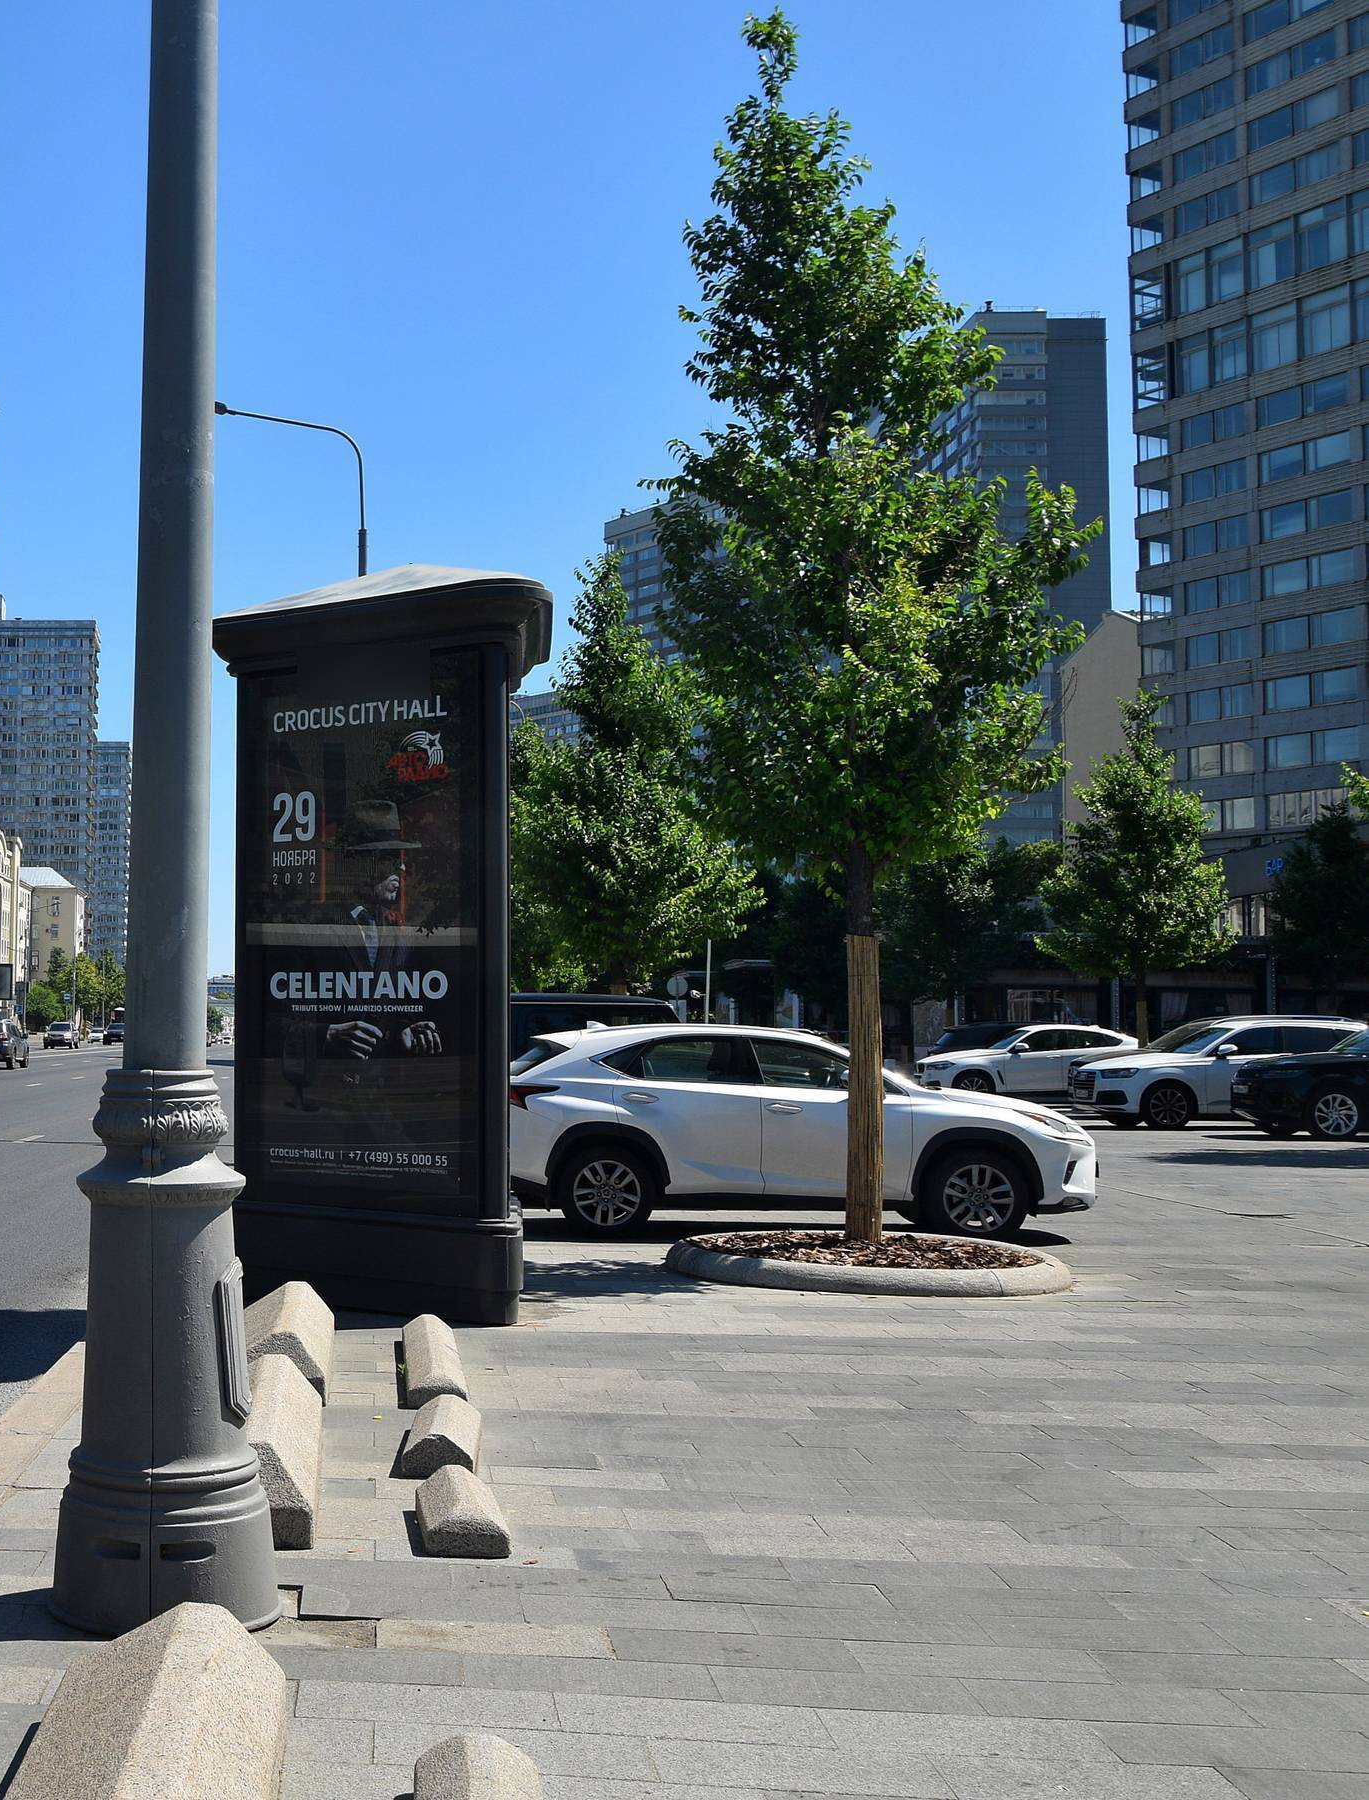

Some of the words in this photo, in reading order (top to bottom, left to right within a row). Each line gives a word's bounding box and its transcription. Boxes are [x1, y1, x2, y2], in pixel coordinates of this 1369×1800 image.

[273, 706, 345, 733] CROCUS
[348, 701, 390, 726] CITY
[393, 695, 448, 720] HALL
[272, 790, 317, 843] 29
[272, 849, 316, 868] НОЯБРЯ
[269, 970, 449, 1000] CELENTANO
[292, 1004, 318, 1013] TRIBUTE
[319, 1004, 342, 1013] SHOW
[348, 1004, 382, 1013] MAURIZIO
[383, 1004, 424, 1014] SCHWEIZER
[270, 1146, 335, 1160] crocus-hall.ru
[348, 1150, 361, 1162] +7
[364, 1150, 393, 1165] (499)
[396, 1153, 409, 1165] 55
[411, 1153, 432, 1166] 000
[435, 1155, 448, 1167] 55
